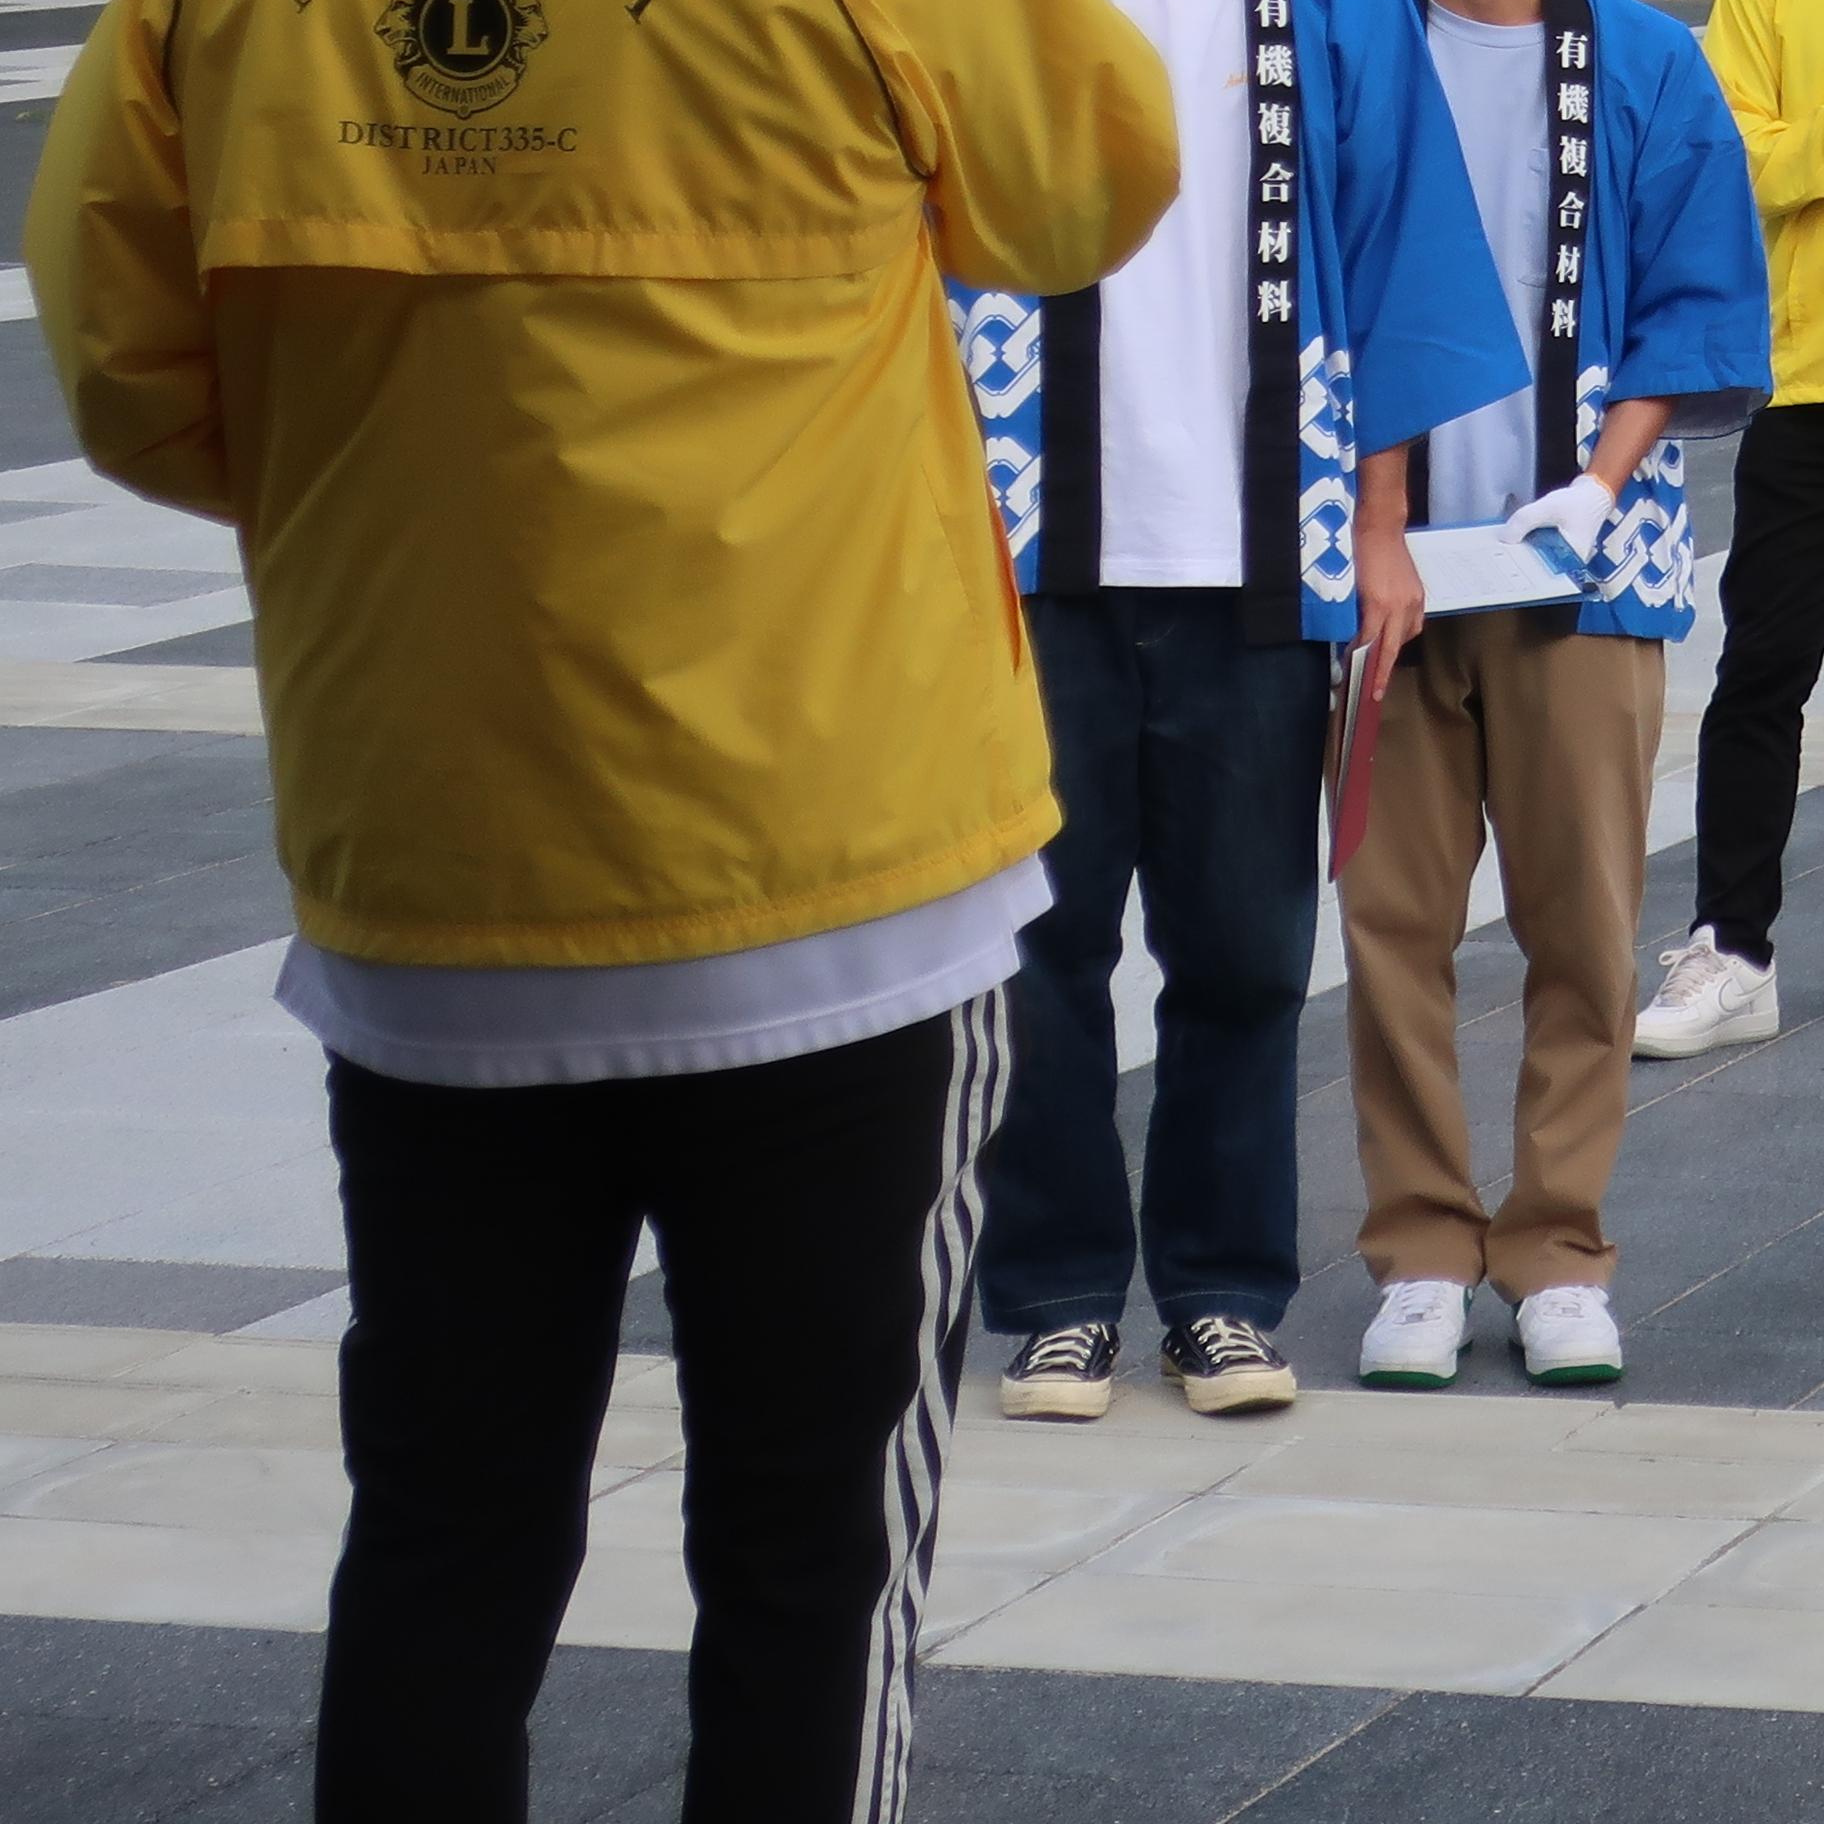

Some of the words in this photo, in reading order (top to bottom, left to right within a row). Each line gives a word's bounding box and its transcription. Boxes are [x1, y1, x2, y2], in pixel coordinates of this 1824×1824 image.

[415, 72, 511, 105] INTERNATIONAL
[422, 155, 497, 175] JAPAN
[1551, 31, 1589, 338] 有機複合材料
